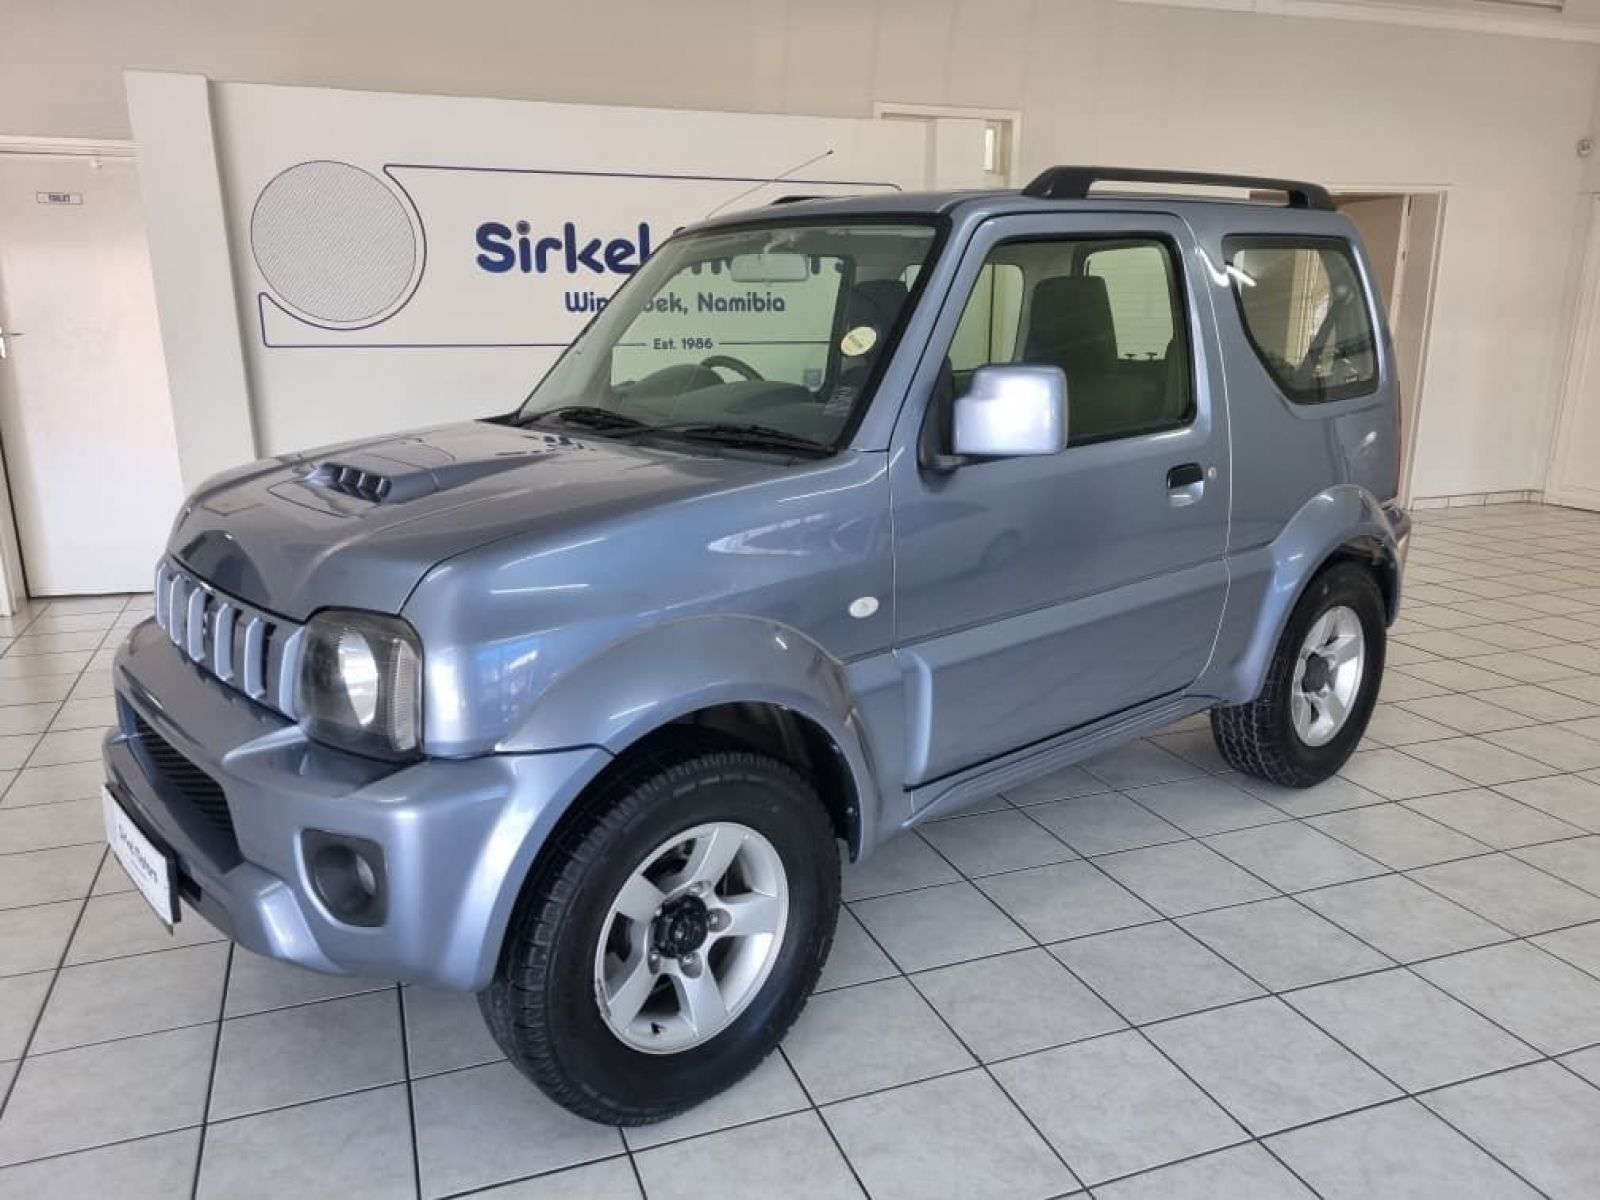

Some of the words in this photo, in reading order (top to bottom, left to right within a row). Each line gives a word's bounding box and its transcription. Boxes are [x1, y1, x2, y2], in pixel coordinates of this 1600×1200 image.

[476, 220, 651, 273] Sirkel
[697, 291, 786, 312] Namibia
[681, 337, 713, 350] 1986
